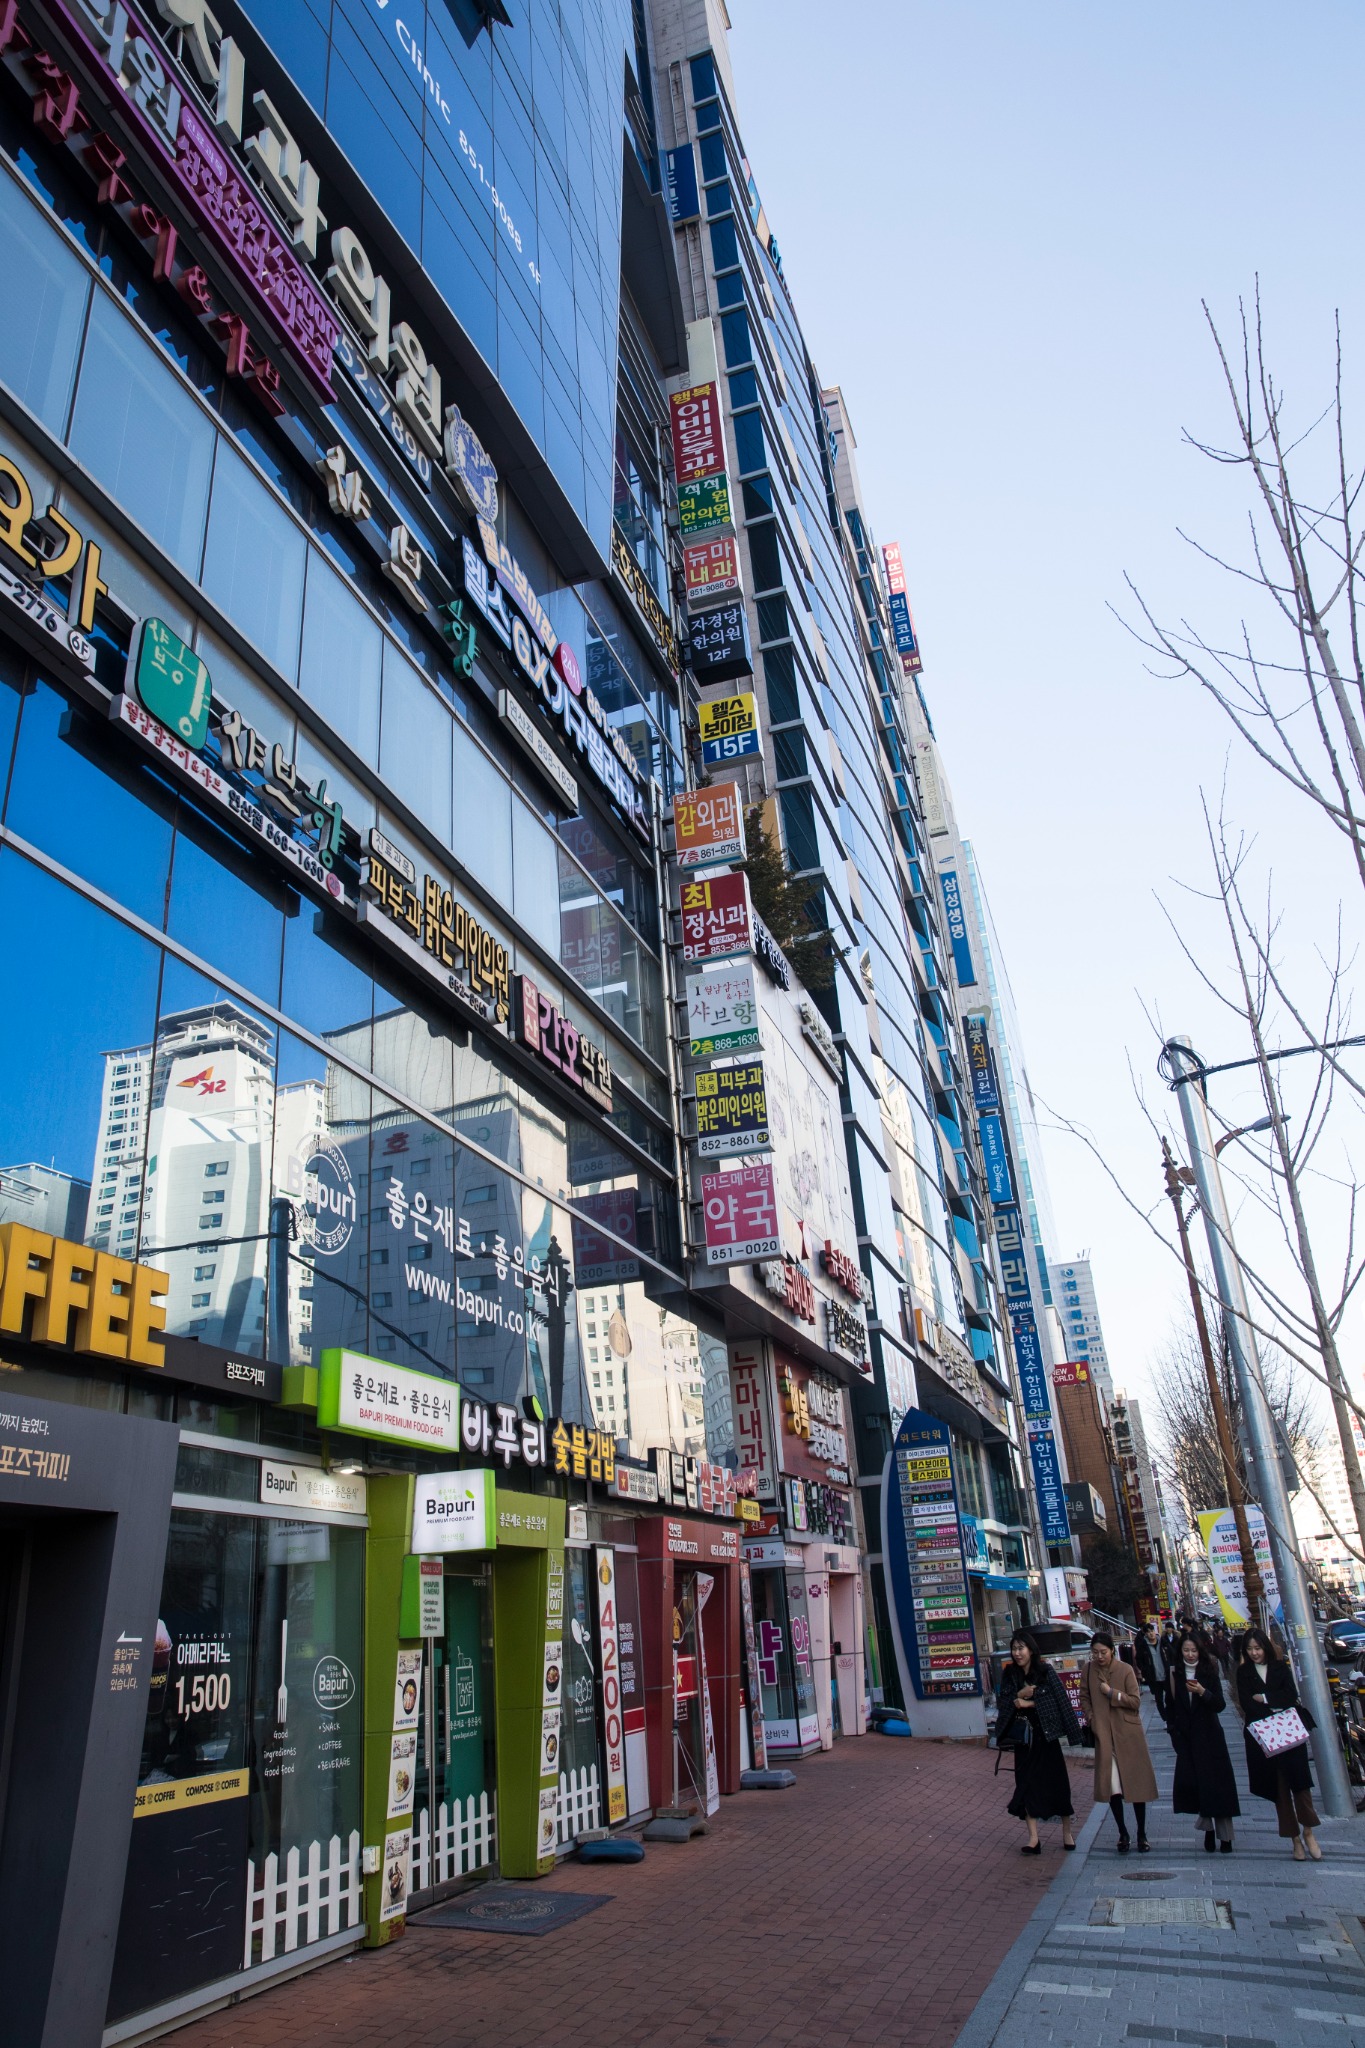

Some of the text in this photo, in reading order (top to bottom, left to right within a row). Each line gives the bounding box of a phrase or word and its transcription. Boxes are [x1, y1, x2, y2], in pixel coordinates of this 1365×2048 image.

[395, 18, 542, 286] Clinic 851-9088 4F
[335, 330, 431, 482] 52-7890
[671, 384, 712, 404] 행복
[676, 398, 718, 473] 이비인후과
[693, 467, 708, 479] 9F
[681, 502, 729, 526] 한의원
[317, 444, 481, 681] 샤브향
[688, 540, 732, 567] 뉴마
[477, 515, 557, 652] 헬스보이짐
[690, 561, 734, 585] 내과
[689, 580, 725, 597] 851-9088
[690, 608, 741, 632] 자경당
[891, 597, 913, 647] 리드코프
[71, 634, 90, 658] 6F
[691, 625, 742, 651] 한의원
[707, 647, 731, 662] 12F
[711, 699, 745, 719] 헬스
[704, 717, 753, 740] 보이짐
[508, 697, 577, 799] 연산점 868-1630
[709, 733, 752, 760] 15F
[219, 711, 346, 869] 샤브향
[675, 792, 698, 806] 부산
[228, 788, 264, 833] 연산점
[266, 822, 325, 884] 868-1630
[712, 826, 736, 840] 의원
[375, 833, 412, 881] 진료과목
[700, 842, 741, 859] 861-8765
[369, 856, 424, 938] 피부과
[684, 881, 712, 910] 최
[943, 876, 966, 941] 삼성생명
[685, 904, 747, 939] 정신과
[423, 874, 510, 1017] 밝은미인의원
[684, 940, 750, 961] 8F 853-3664
[523, 979, 540, 1044] 연산
[690, 1000, 757, 1027] 샤브향
[714, 1031, 759, 1051] 868-1630
[719, 1066, 763, 1090] 피부과
[697, 1090, 768, 1133] 밝은미인의원
[701, 1131, 769, 1151] 852-8861 5F
[986, 1123, 1005, 1194] SPARKS Disney
[337, 1160, 350, 1183] CAFE
[704, 1167, 772, 1191] 위드메디칼
[287, 1155, 357, 1223] Bapuri
[706, 1190, 775, 1241] 약국
[711, 1240, 778, 1261] 851-0020
[994, 1212, 1028, 1297] 밀란
[405, 1262, 543, 1342] www.bapuri.co.kr
[226, 1361, 266, 1387] 컴포즈커피
[359, 1407, 444, 1437] BAPURI PREMIUM FOOD CAFE
[732, 1351, 767, 1472] 뉴마내과
[20, 1416, 50, 1436] 높였다.
[461, 1398, 617, 1484] 바푸리 숯불김밥
[0, 1444, 71, 1482] 포즈커피!
[266, 1471, 298, 1494] Bapuri
[699, 1460, 738, 1517] 쌀국수
[1034, 1442, 1064, 1526] 한빛프롤로
[426, 1498, 475, 1518] Bapuri
[750, 1519, 767, 1531] 진료
[1047, 1526, 1067, 1538] 의원
[549, 1588, 563, 1599] TAKE
[550, 1600, 561, 1611] OUT
[927, 1608, 966, 1618] 뉴욕서울치과
[113, 1648, 141, 1661] 출입구는
[177, 1642, 231, 1665] 아메리카노
[792, 1615, 811, 1677] 약
[111, 1663, 133, 1676] 좌측에
[110, 1677, 139, 1692] 있습니다.
[318, 1673, 349, 1694] Bapuri
[457, 1682, 473, 1694] TAKE
[951, 1682, 975, 1692] 설렁탕
[175, 1673, 232, 1722] 1,500
[459, 1694, 472, 1707] OUT
[273, 1729, 289, 1740] Good
[322, 1722, 341, 1733] SNACK
[764, 1729, 790, 1739] 상비약
[263, 1746, 297, 1763] ingredients
[321, 1740, 343, 1751] COFFEE
[264, 1763, 295, 1777] Good food
[320, 1757, 351, 1771] BEVERAGE
[154, 1789, 176, 1804] COFFEE
[185, 1778, 241, 1797] COMPOSE COFFEE
